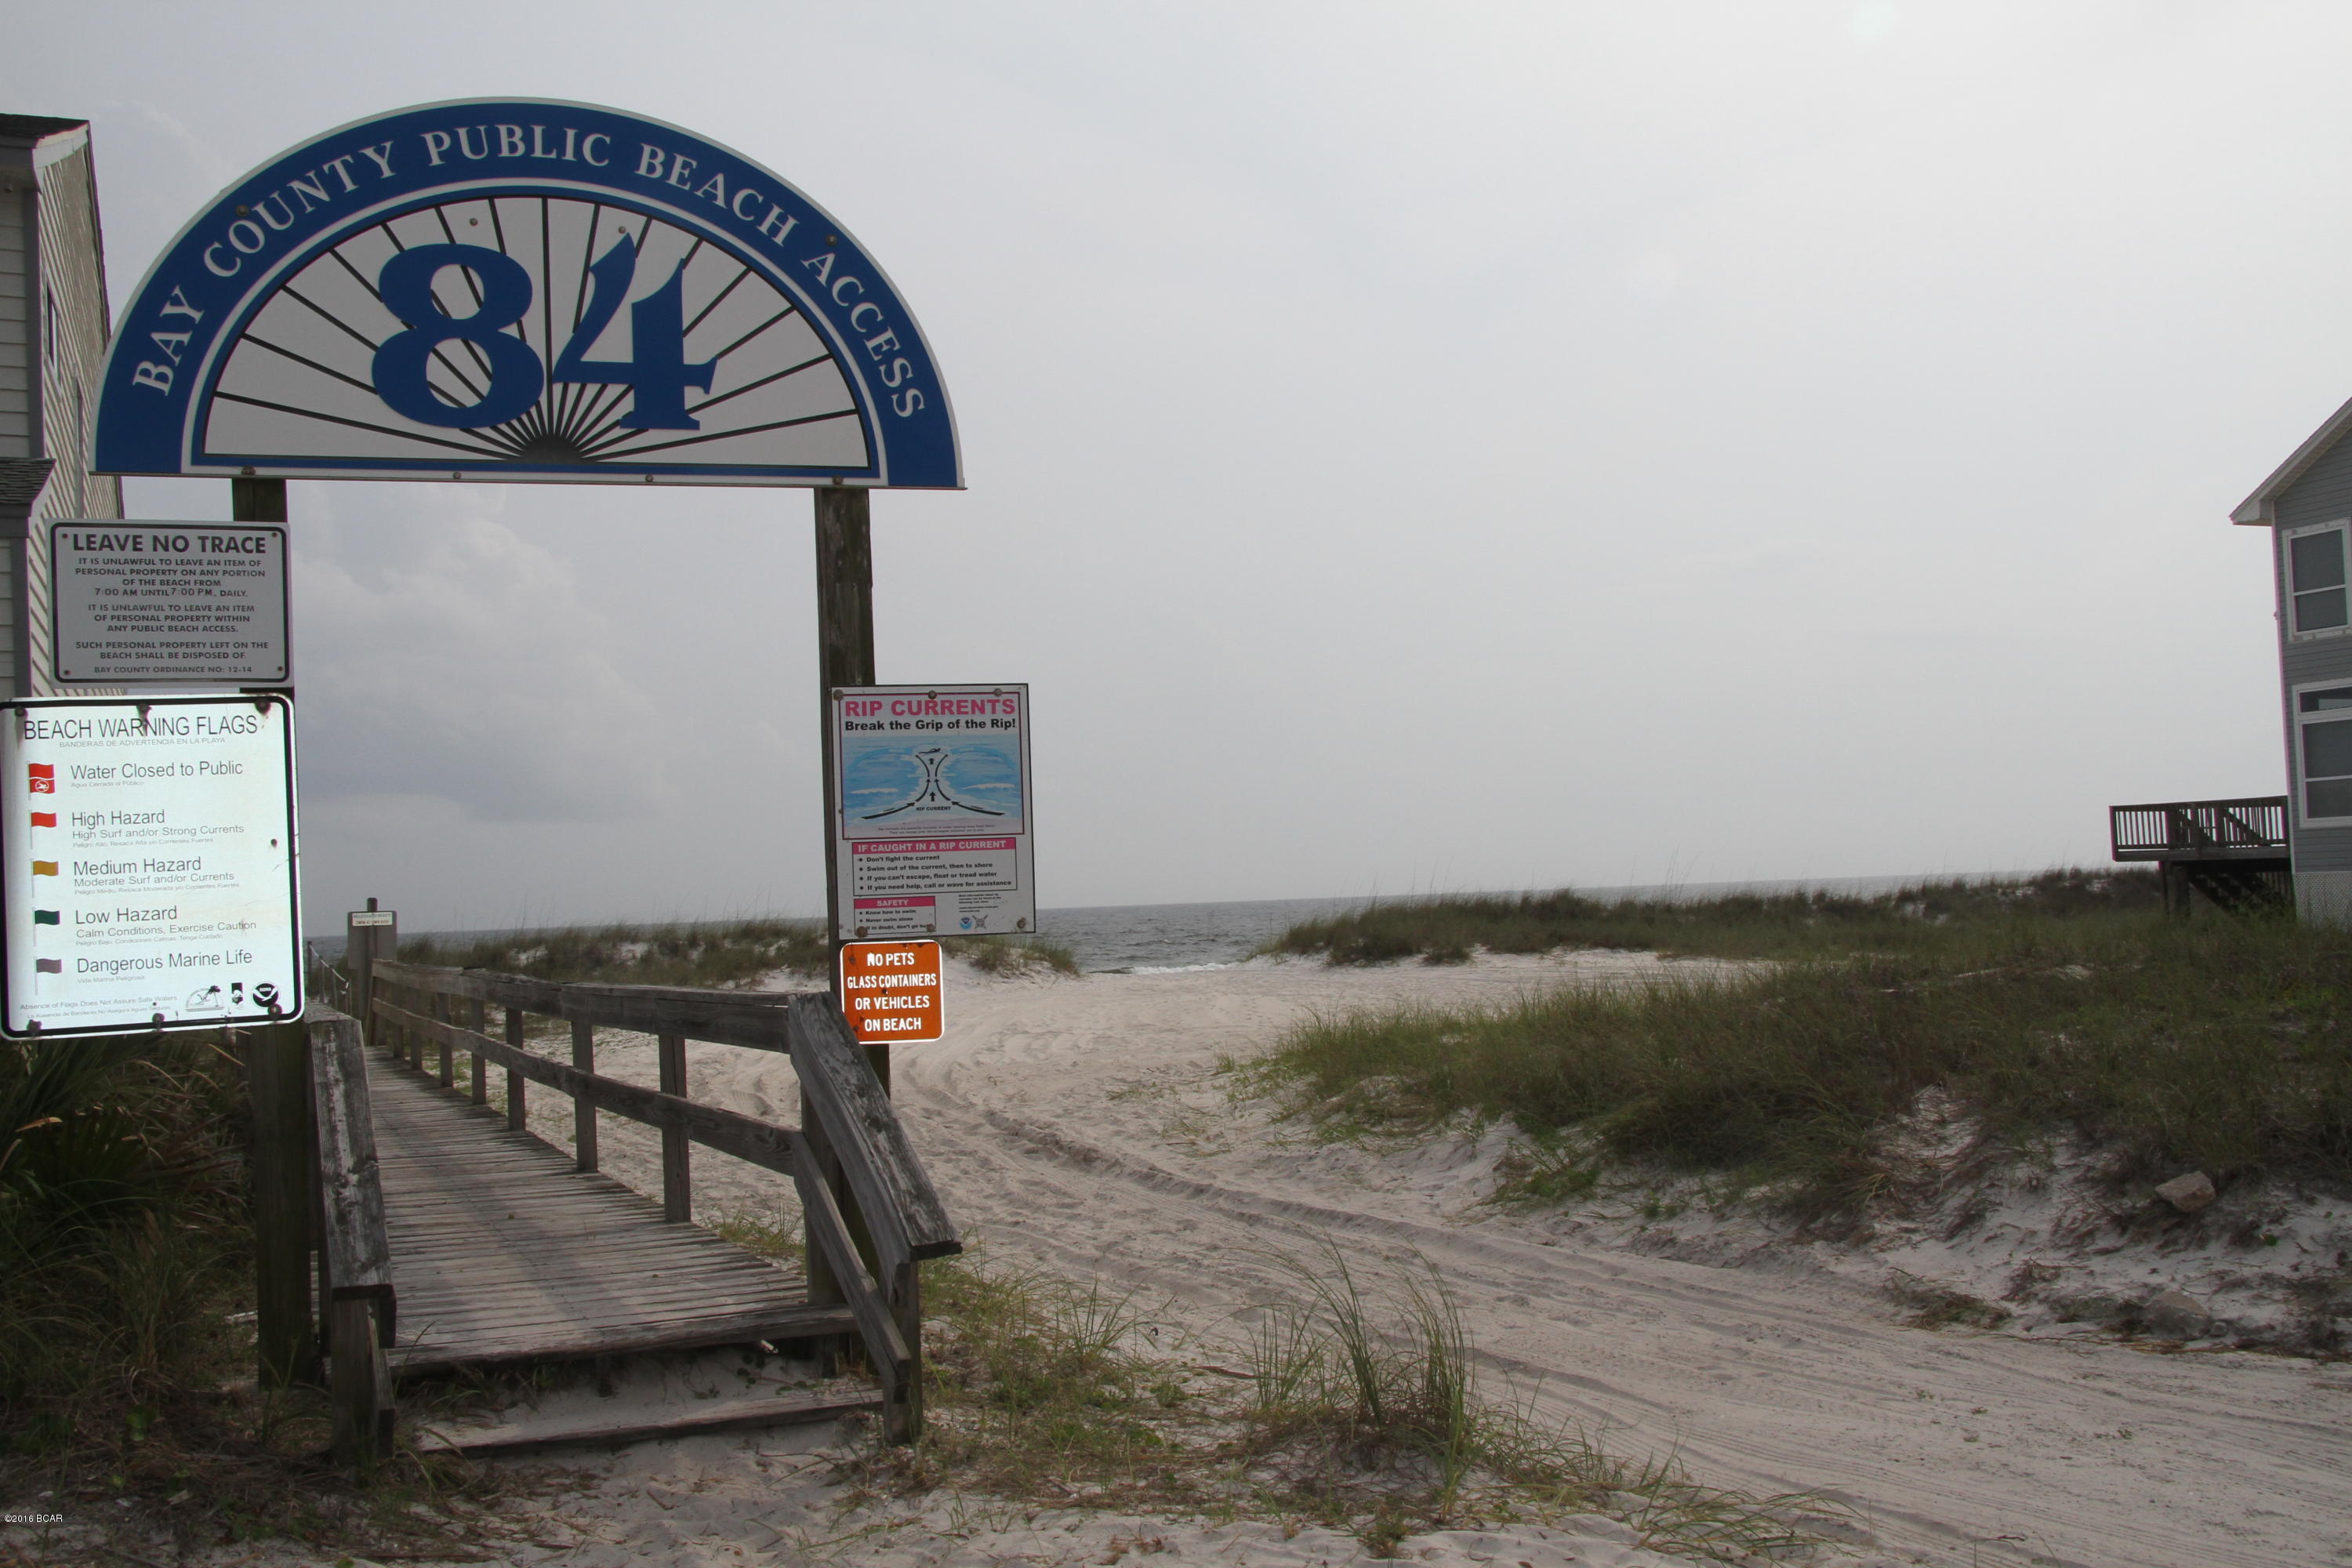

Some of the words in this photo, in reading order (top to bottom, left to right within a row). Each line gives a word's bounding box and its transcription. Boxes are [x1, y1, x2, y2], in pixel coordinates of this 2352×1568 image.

[132, 285, 204, 396] BAY
[203, 140, 396, 277] COUNTY
[421, 125, 610, 167] PUBLIC
[634, 143, 800, 246] BEACH
[800, 252, 926, 418] ACCESS
[371, 232, 718, 430] 84
[74, 534, 143, 552] LEAVE
[153, 535, 189, 553] NO
[198, 536, 266, 554] TRACE
[845, 700, 882, 717] RIP
[891, 699, 1015, 716] CURRENTS
[25, 719, 92, 740] BEACH
[99, 717, 189, 737] WARNING
[198, 715, 258, 735] FLAGS
[845, 721, 884, 731] Break
[890, 720, 911, 730] the
[916, 720, 942, 731] Grip
[948, 719, 960, 728] of
[966, 719, 985, 728] the
[991, 718, 1015, 730] Rip!
[71, 765, 116, 779] Water
[122, 763, 174, 778] Closed
[181, 763, 194, 775] to
[200, 760, 244, 775] Public
[72, 811, 104, 829] High
[111, 809, 165, 825] Hazard
[73, 830, 96, 840] High
[100, 829, 122, 838] Surf
[125, 828, 158, 837] and/or
[163, 827, 196, 837] Strong
[201, 825, 244, 834] Currents
[959, 840, 1006, 849] CURRENT
[74, 860, 137, 876] Medium
[144, 856, 201, 873] Hazard
[74, 877, 125, 887] Moderate
[129, 876, 151, 884] Surf
[154, 875, 187, 884] and/or
[191, 873, 234, 882] Currents
[76, 909, 110, 924] Low
[117, 906, 177, 922] Hazard
[77, 928, 104, 938] Calm
[108, 927, 165, 936] Conditions,
[170, 924, 213, 934] Exercise
[218, 921, 256, 931] Caution
[78, 956, 163, 975] Dangerous
[169, 953, 220, 967] Marine
[227, 949, 252, 964] Life
[867, 953, 883, 966] NO
[886, 953, 915, 966] PETS
[848, 976, 877, 989] GLASS
[879, 974, 936, 987] CONTAINERS
[855, 997, 870, 1010] OR
[874, 996, 930, 1009] VEHICLES
[865, 1019, 880, 1031] ON
[884, 1018, 921, 1031] BEACH
